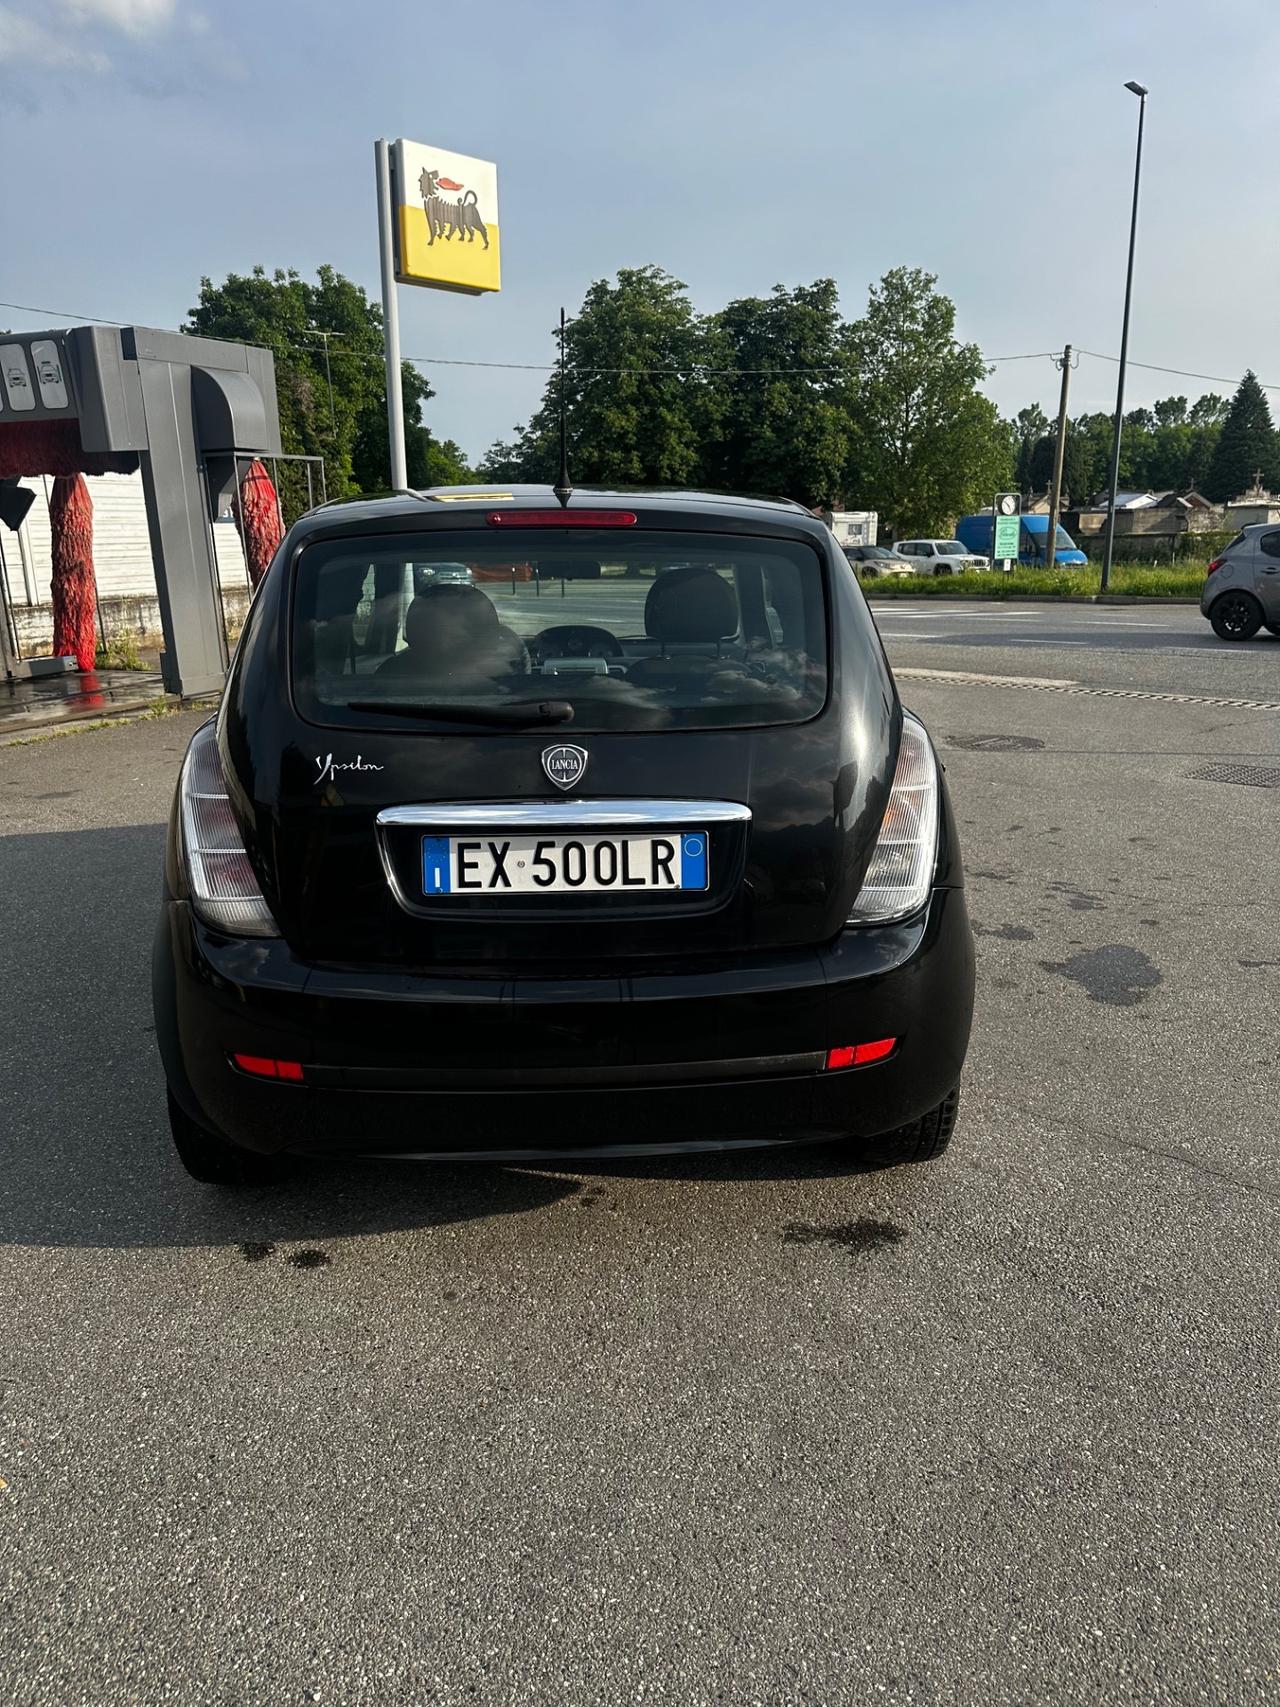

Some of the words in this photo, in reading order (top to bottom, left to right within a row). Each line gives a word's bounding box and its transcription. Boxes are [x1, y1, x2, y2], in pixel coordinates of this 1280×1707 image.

[313, 752, 384, 785] Ypsilon
[551, 759, 579, 770] LANCIA
[434, 867, 441, 888] I
[457, 841, 512, 889] EX
[532, 839, 676, 887] 500LR
